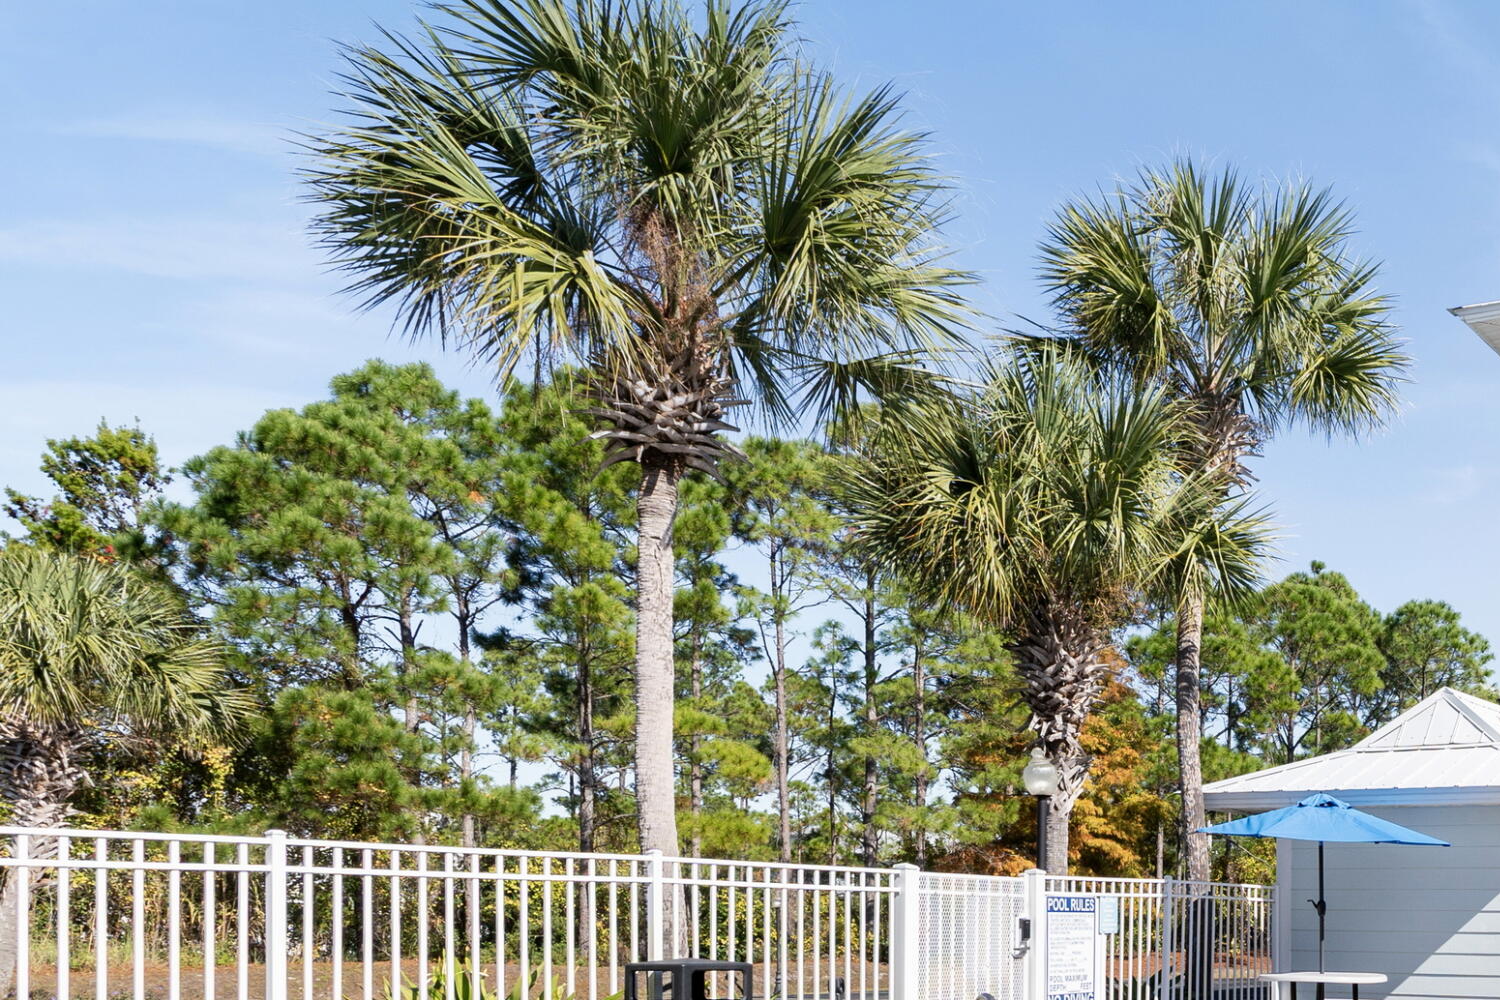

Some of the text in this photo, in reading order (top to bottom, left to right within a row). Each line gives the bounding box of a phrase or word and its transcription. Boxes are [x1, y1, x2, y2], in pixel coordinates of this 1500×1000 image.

[1047, 898, 1095, 912] POOL RULES
[1050, 982, 1092, 992] DEPTH FEET
